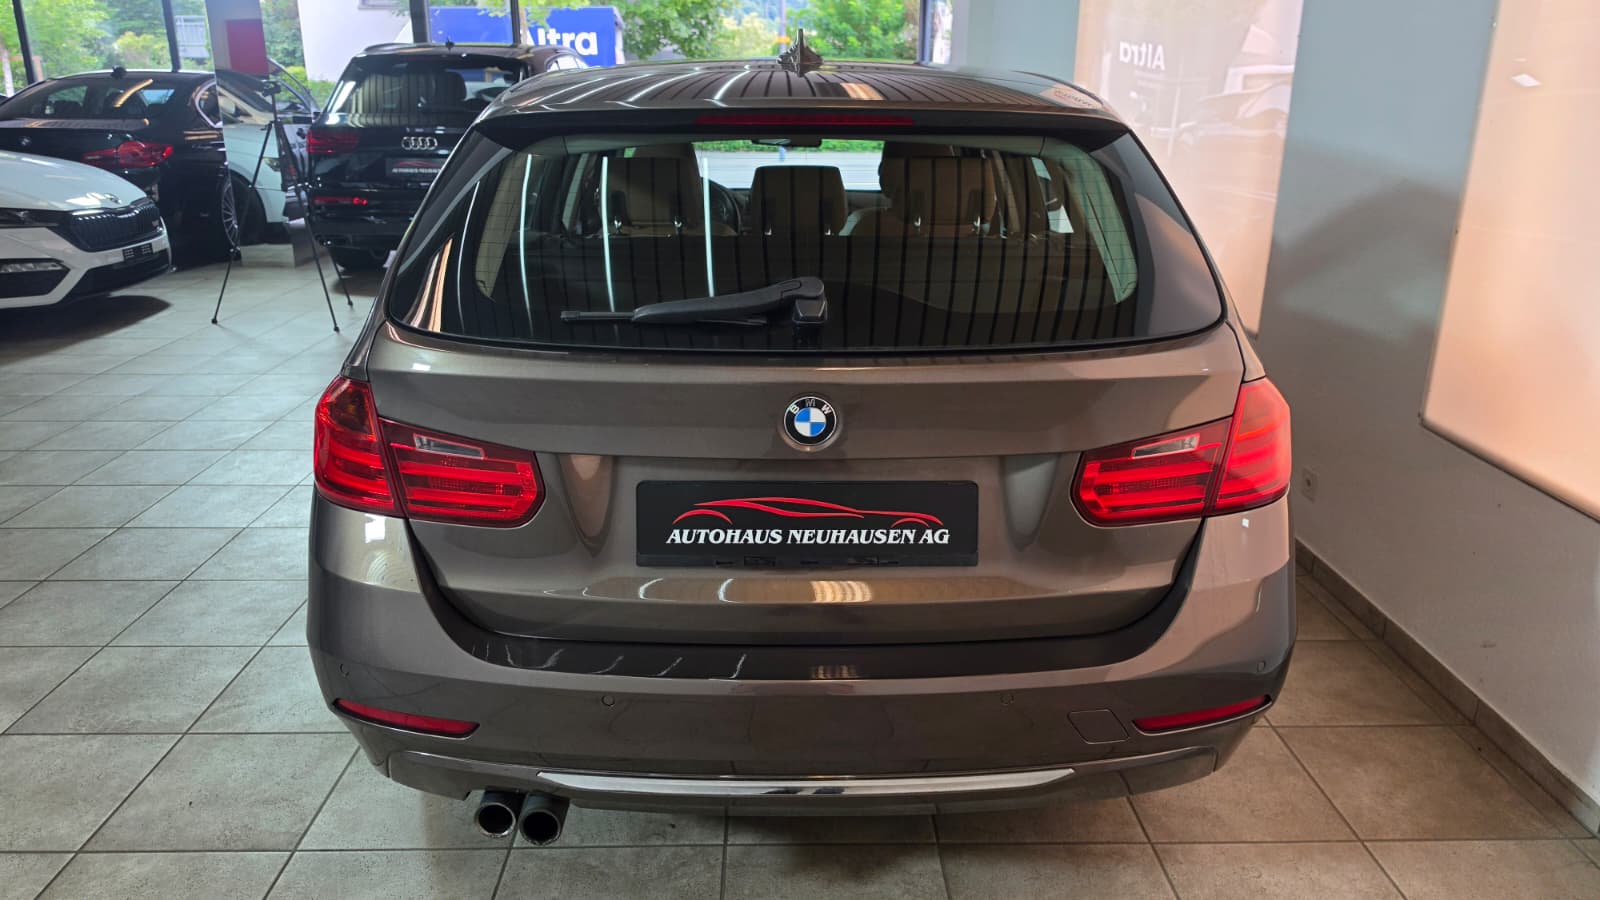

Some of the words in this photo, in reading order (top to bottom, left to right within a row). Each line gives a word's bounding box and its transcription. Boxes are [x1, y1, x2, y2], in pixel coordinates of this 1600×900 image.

[789, 399, 832, 415] BMW
[666, 528, 783, 544] AUTOHAUS
[786, 529, 917, 544] NEUHAUSEN
[918, 529, 950, 544] AG
